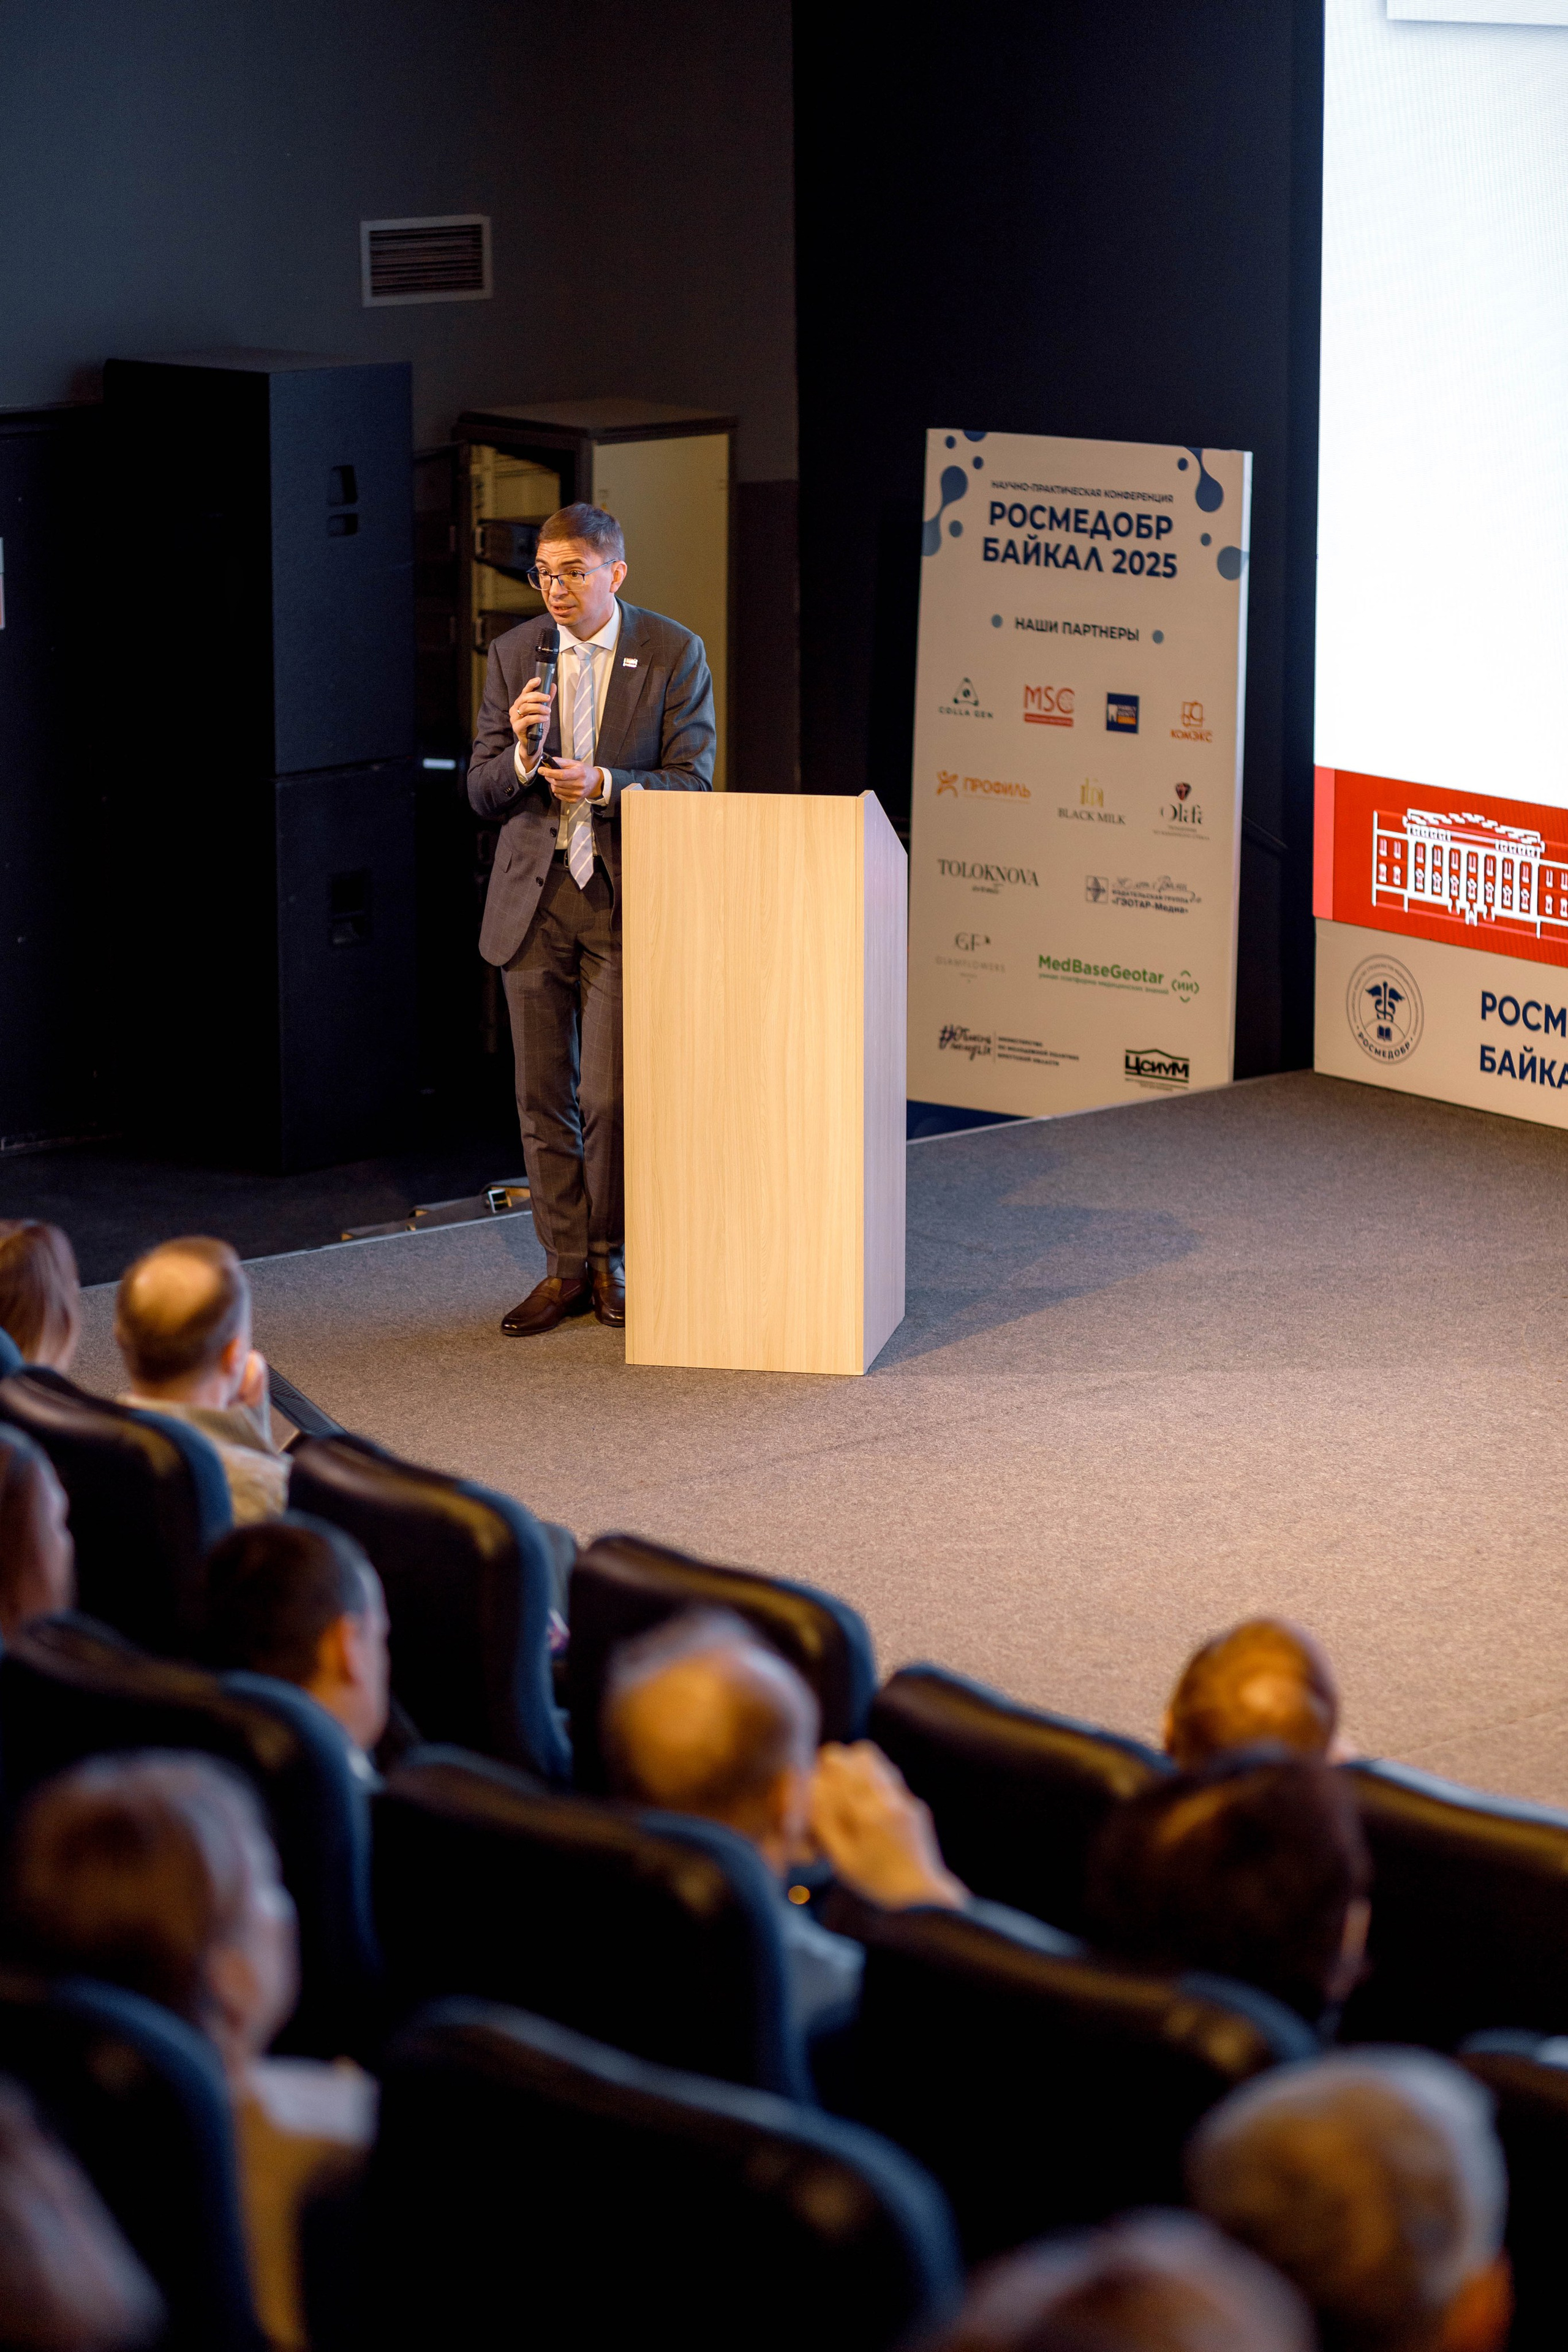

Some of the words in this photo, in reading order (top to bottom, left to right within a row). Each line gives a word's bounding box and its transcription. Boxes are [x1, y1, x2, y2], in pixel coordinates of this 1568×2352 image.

[992, 481, 1102, 497] НАУЧНО-ПРАКТИЧЕСКАЯ
[1104, 489, 1174, 503] КОНФЕРЕНЦИЯ
[989, 500, 1174, 540] РОСМЕДОБР
[983, 533, 1103, 572] БАЙКАЛ
[1112, 548, 1178, 578] 2025
[1015, 617, 1059, 633] НАШИ
[1063, 622, 1139, 641] ПАРТНЕРЫ
[1023, 684, 1075, 714] MSC
[963, 777, 1032, 798] ПРОФИЛЬ
[1058, 808, 1095, 821] BLACK
[1097, 812, 1125, 825] MILK
[938, 859, 1039, 887] TOLOKNOVA
[1038, 954, 1164, 984] MedBaseGeotar
[1357, 1031, 1412, 1060] РОСМЕДОБР
